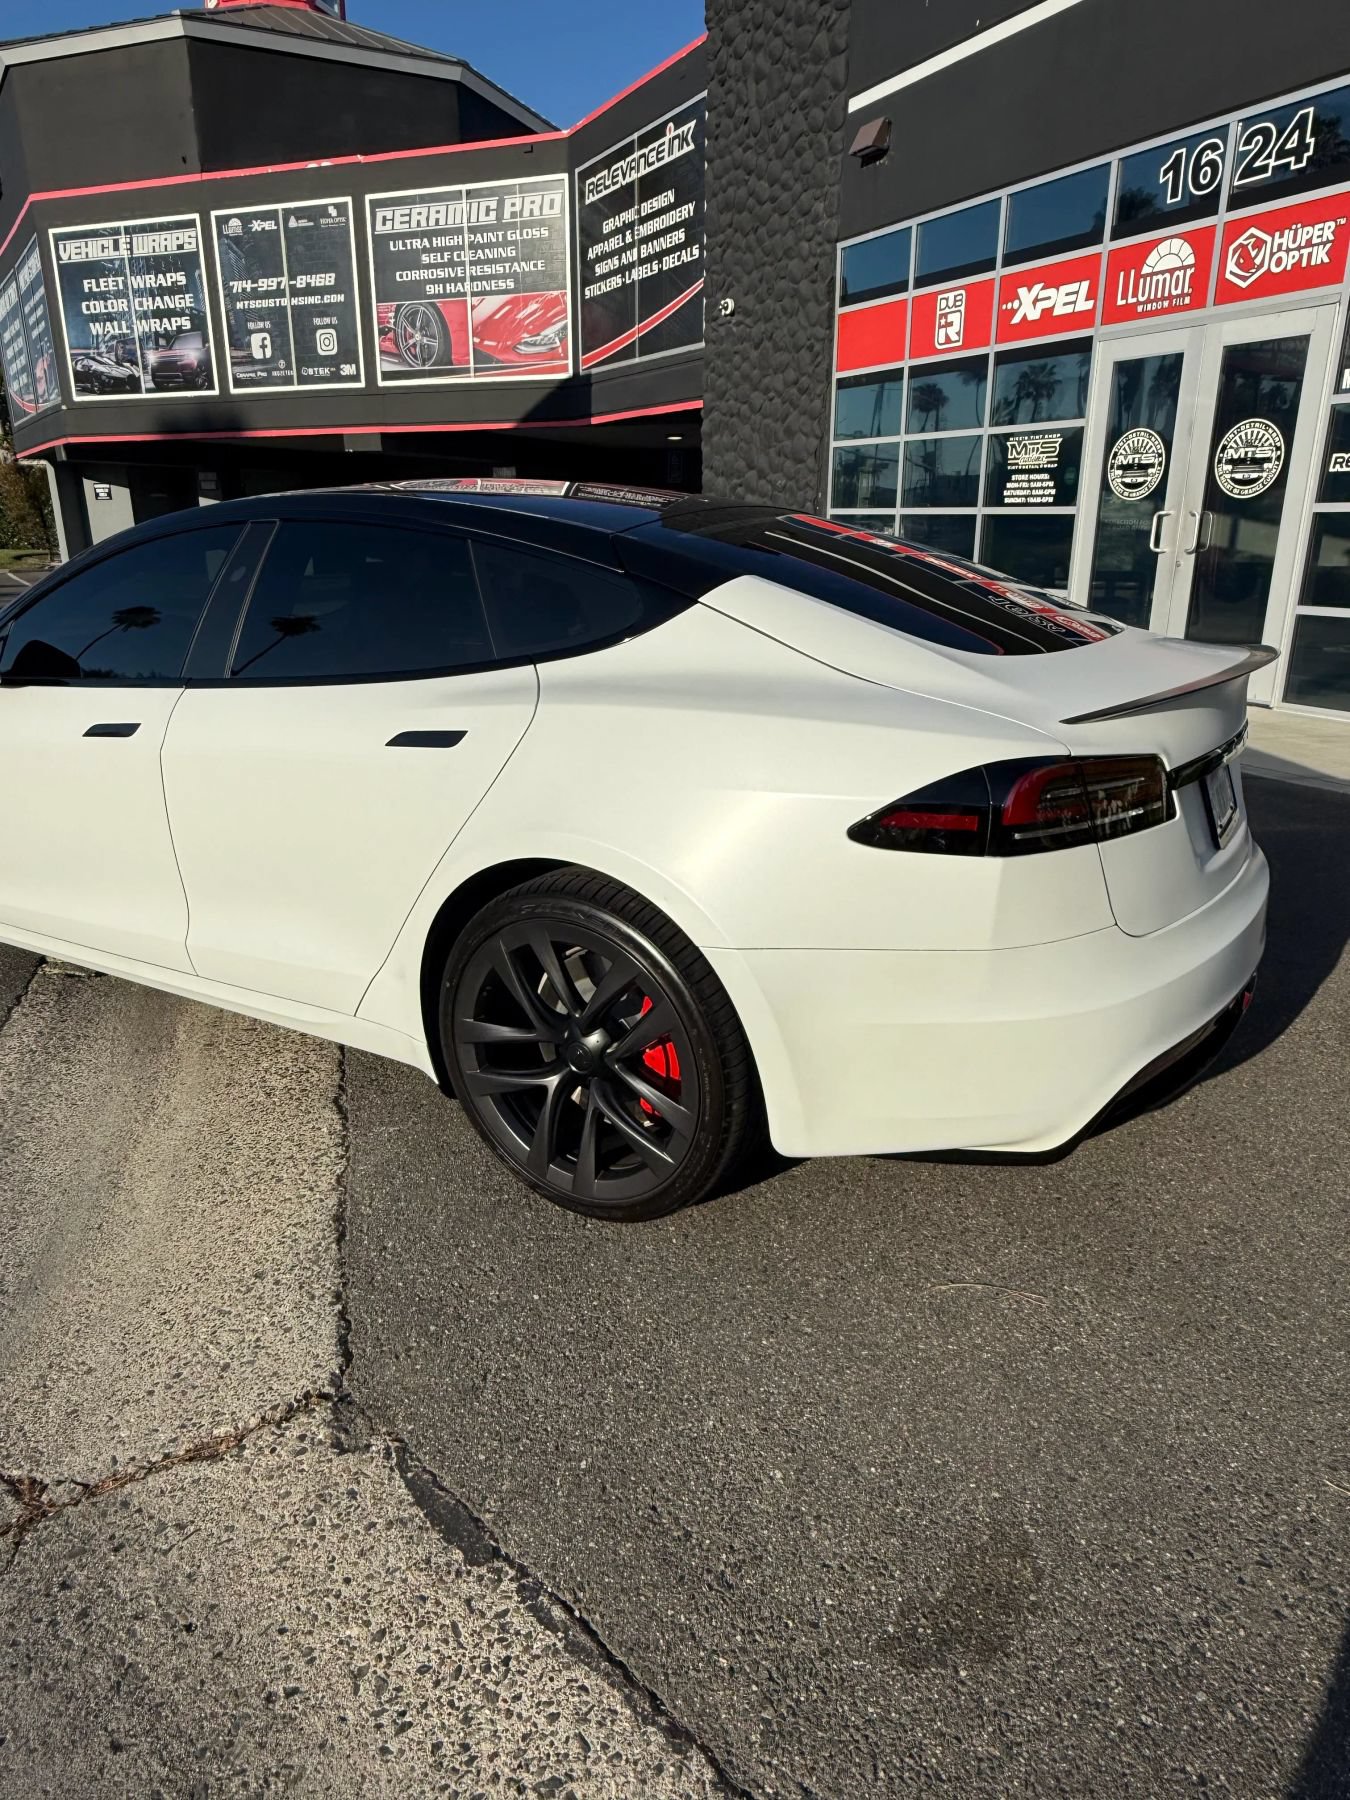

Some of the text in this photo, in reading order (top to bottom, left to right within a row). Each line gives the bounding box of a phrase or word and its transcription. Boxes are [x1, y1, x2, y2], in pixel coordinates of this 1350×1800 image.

[375, 193, 563, 232] CERAMIC PRO
[603, 188, 675, 234] GRAPHIC DESIGN
[249, 220, 277, 231] XPEL
[587, 201, 696, 261] APPAREL & EMBROIDERY
[1273, 221, 1335, 251] HÜPER
[58, 231, 197, 260] VEHICLE WRAPS
[389, 227, 549, 251] ULTRA HIGH PAINT GLOSS
[421, 246, 516, 264] SELF CLEANING
[595, 228, 686, 277] SIGNS AND BANNERS
[1270, 243, 1333, 273] OPTIK
[396, 260, 545, 282] CORROSIVE RESISTANCE
[584, 274, 623, 300] STICKERS
[662, 244, 700, 271] DECALS
[83, 272, 186, 292] FLEET WRAPS
[230, 273, 335, 293] 714-997-8468
[426, 279, 515, 295] 9H HARDNESS
[82, 294, 194, 314] COLOR CHANGE
[939, 293, 964, 312] DUB
[1010, 280, 1095, 325] XPEL
[1137, 296, 1191, 313] WINDOW FILM
[90, 317, 191, 335] WALL WRAPS
[340, 364, 356, 375] 3M
[1223, 422, 1281, 447] TINT DETAIL WRAP
[1007, 438, 1063, 458] MTS
[1227, 447, 1275, 459] MTS
[1117, 454, 1156, 464] MTS
[1220, 475, 1233, 491] HEART
[1240, 484, 1264, 495] ORANGE
[1263, 461, 1280, 485] COUNTY
